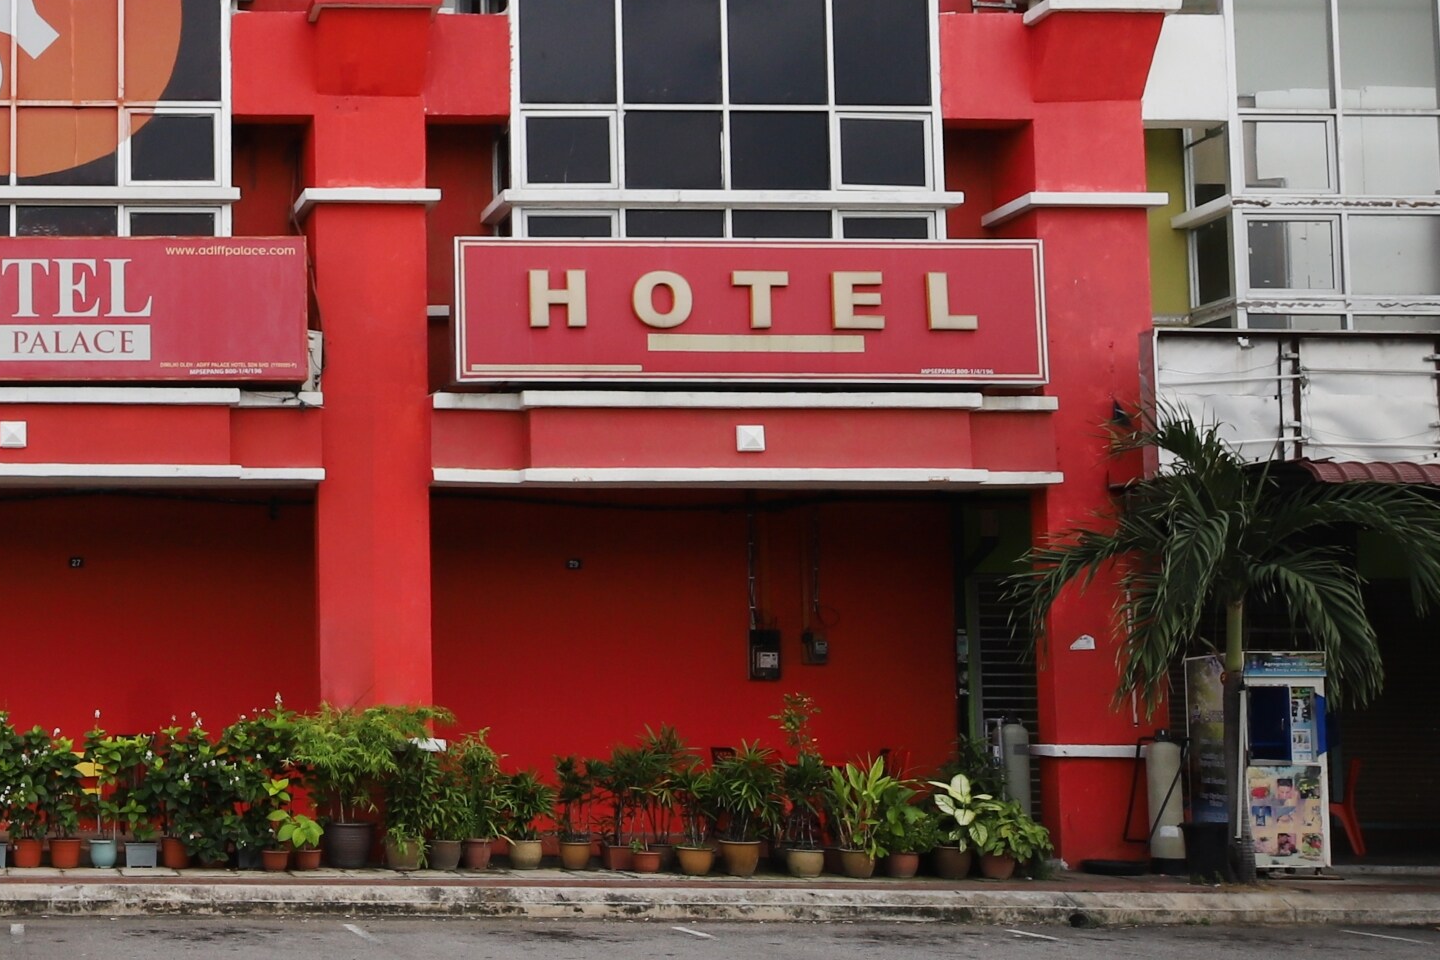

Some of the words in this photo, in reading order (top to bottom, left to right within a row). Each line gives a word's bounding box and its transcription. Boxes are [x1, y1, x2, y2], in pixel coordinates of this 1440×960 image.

[165, 245, 296, 257] www.adiffpalace.com
[527, 269, 979, 331] HOTEL
[12, 330, 135, 355] PALACE
